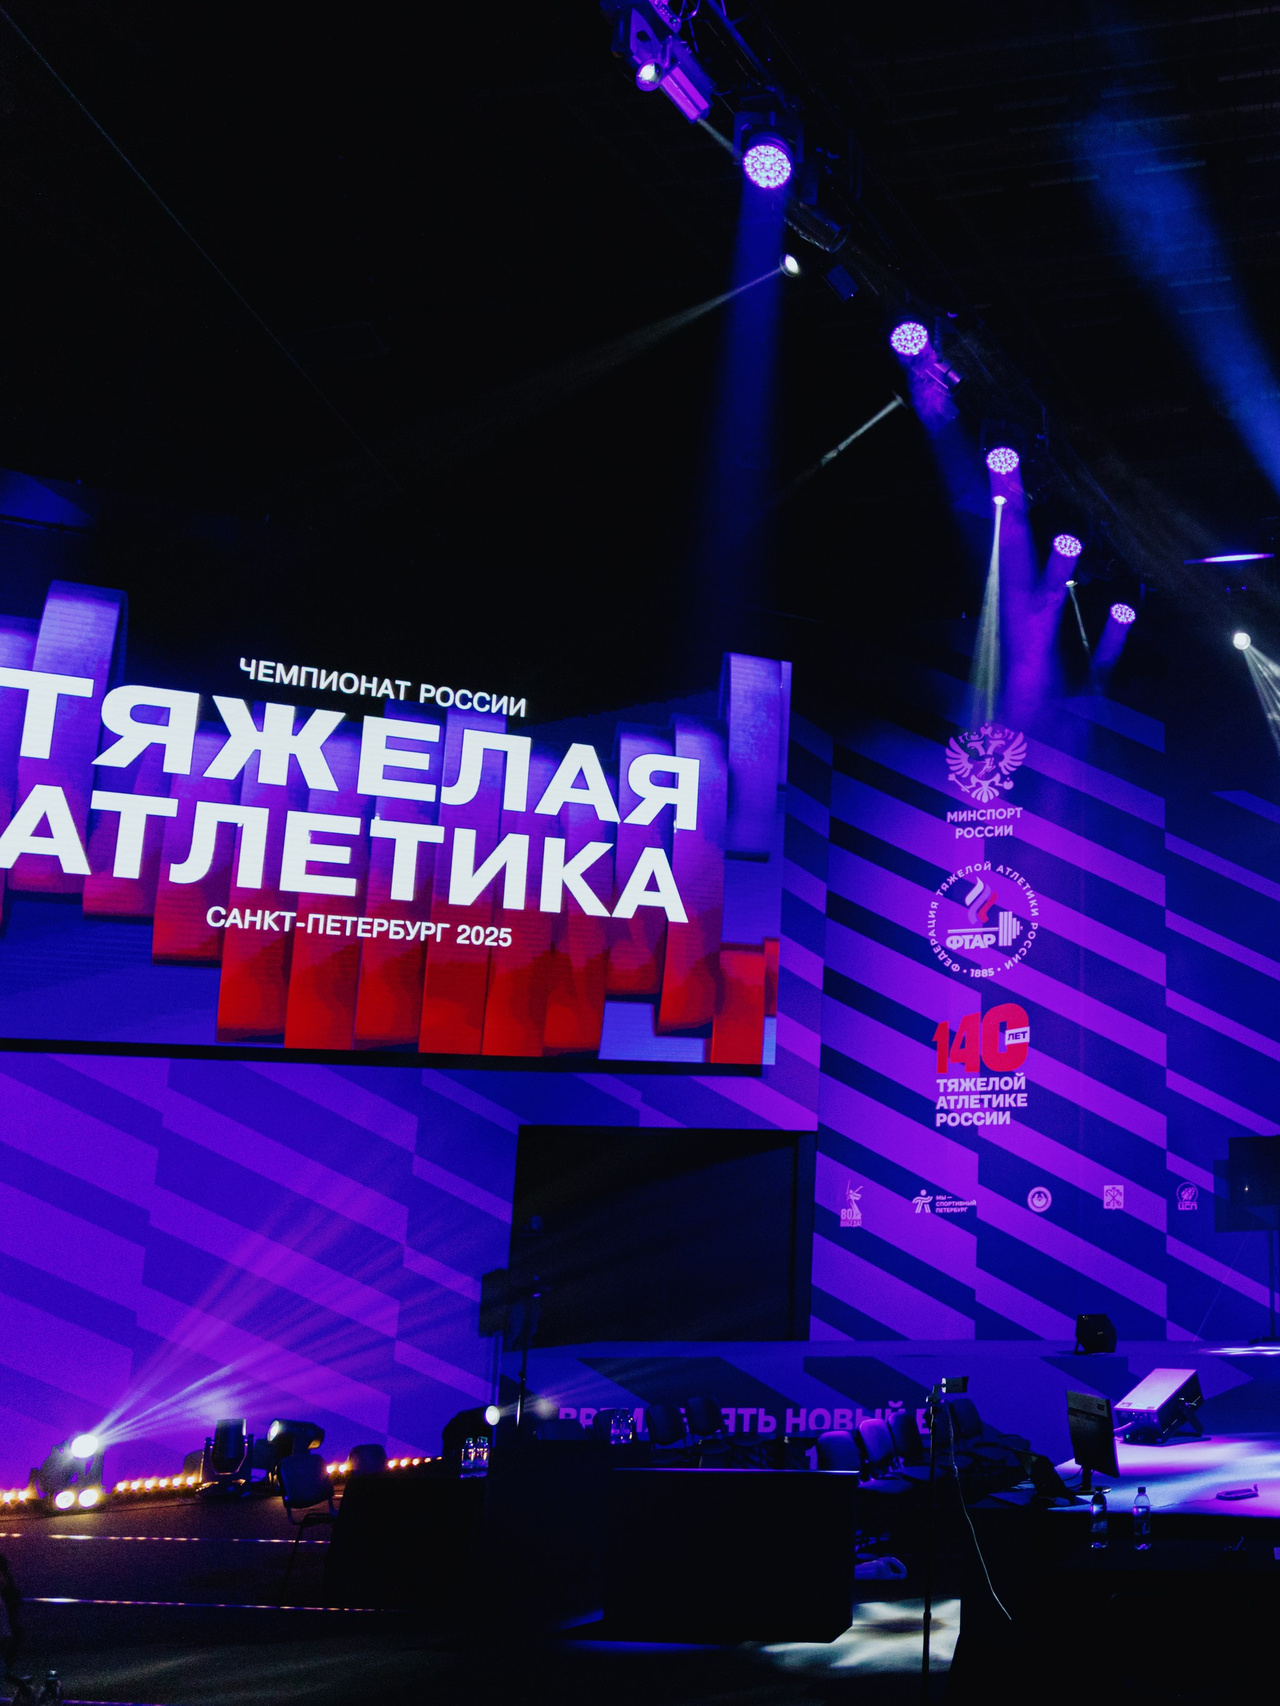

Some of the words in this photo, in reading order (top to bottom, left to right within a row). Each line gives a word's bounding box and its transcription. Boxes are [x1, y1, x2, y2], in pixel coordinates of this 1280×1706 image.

[239, 657, 412, 700] ЧЕМПИОНАТ
[418, 683, 527, 718] РОССИИ
[0, 667, 701, 832] ТЯЖЕЛАЯ
[946, 807, 1023, 823] МИНСПОРТ
[955, 825, 1013, 839] РОССИИ
[0, 784, 689, 924] АТЛЕТИКА
[935, 861, 991, 897] ТЯЖЕЛОЙ
[996, 865, 1039, 916] АТЛЕТИКИ
[206, 905, 451, 945] САНКТ-ПЕТЕРБУРГ
[456, 924, 513, 949] 2025
[927, 901, 960, 972] ФЕДЕРАЦИЯ
[945, 933, 996, 950] ФТАР
[1004, 922, 1039, 969] РОССИИ
[970, 968, 995, 978] 1885
[932, 1003, 1029, 1074] 140
[1007, 1031, 1028, 1041] ЛЕТ
[936, 1072, 1026, 1093] ТЯЖЕЛОЙ
[935, 1093, 1028, 1110] АТЛЕТИКЕ
[935, 1111, 1011, 1127] РОССИИ
